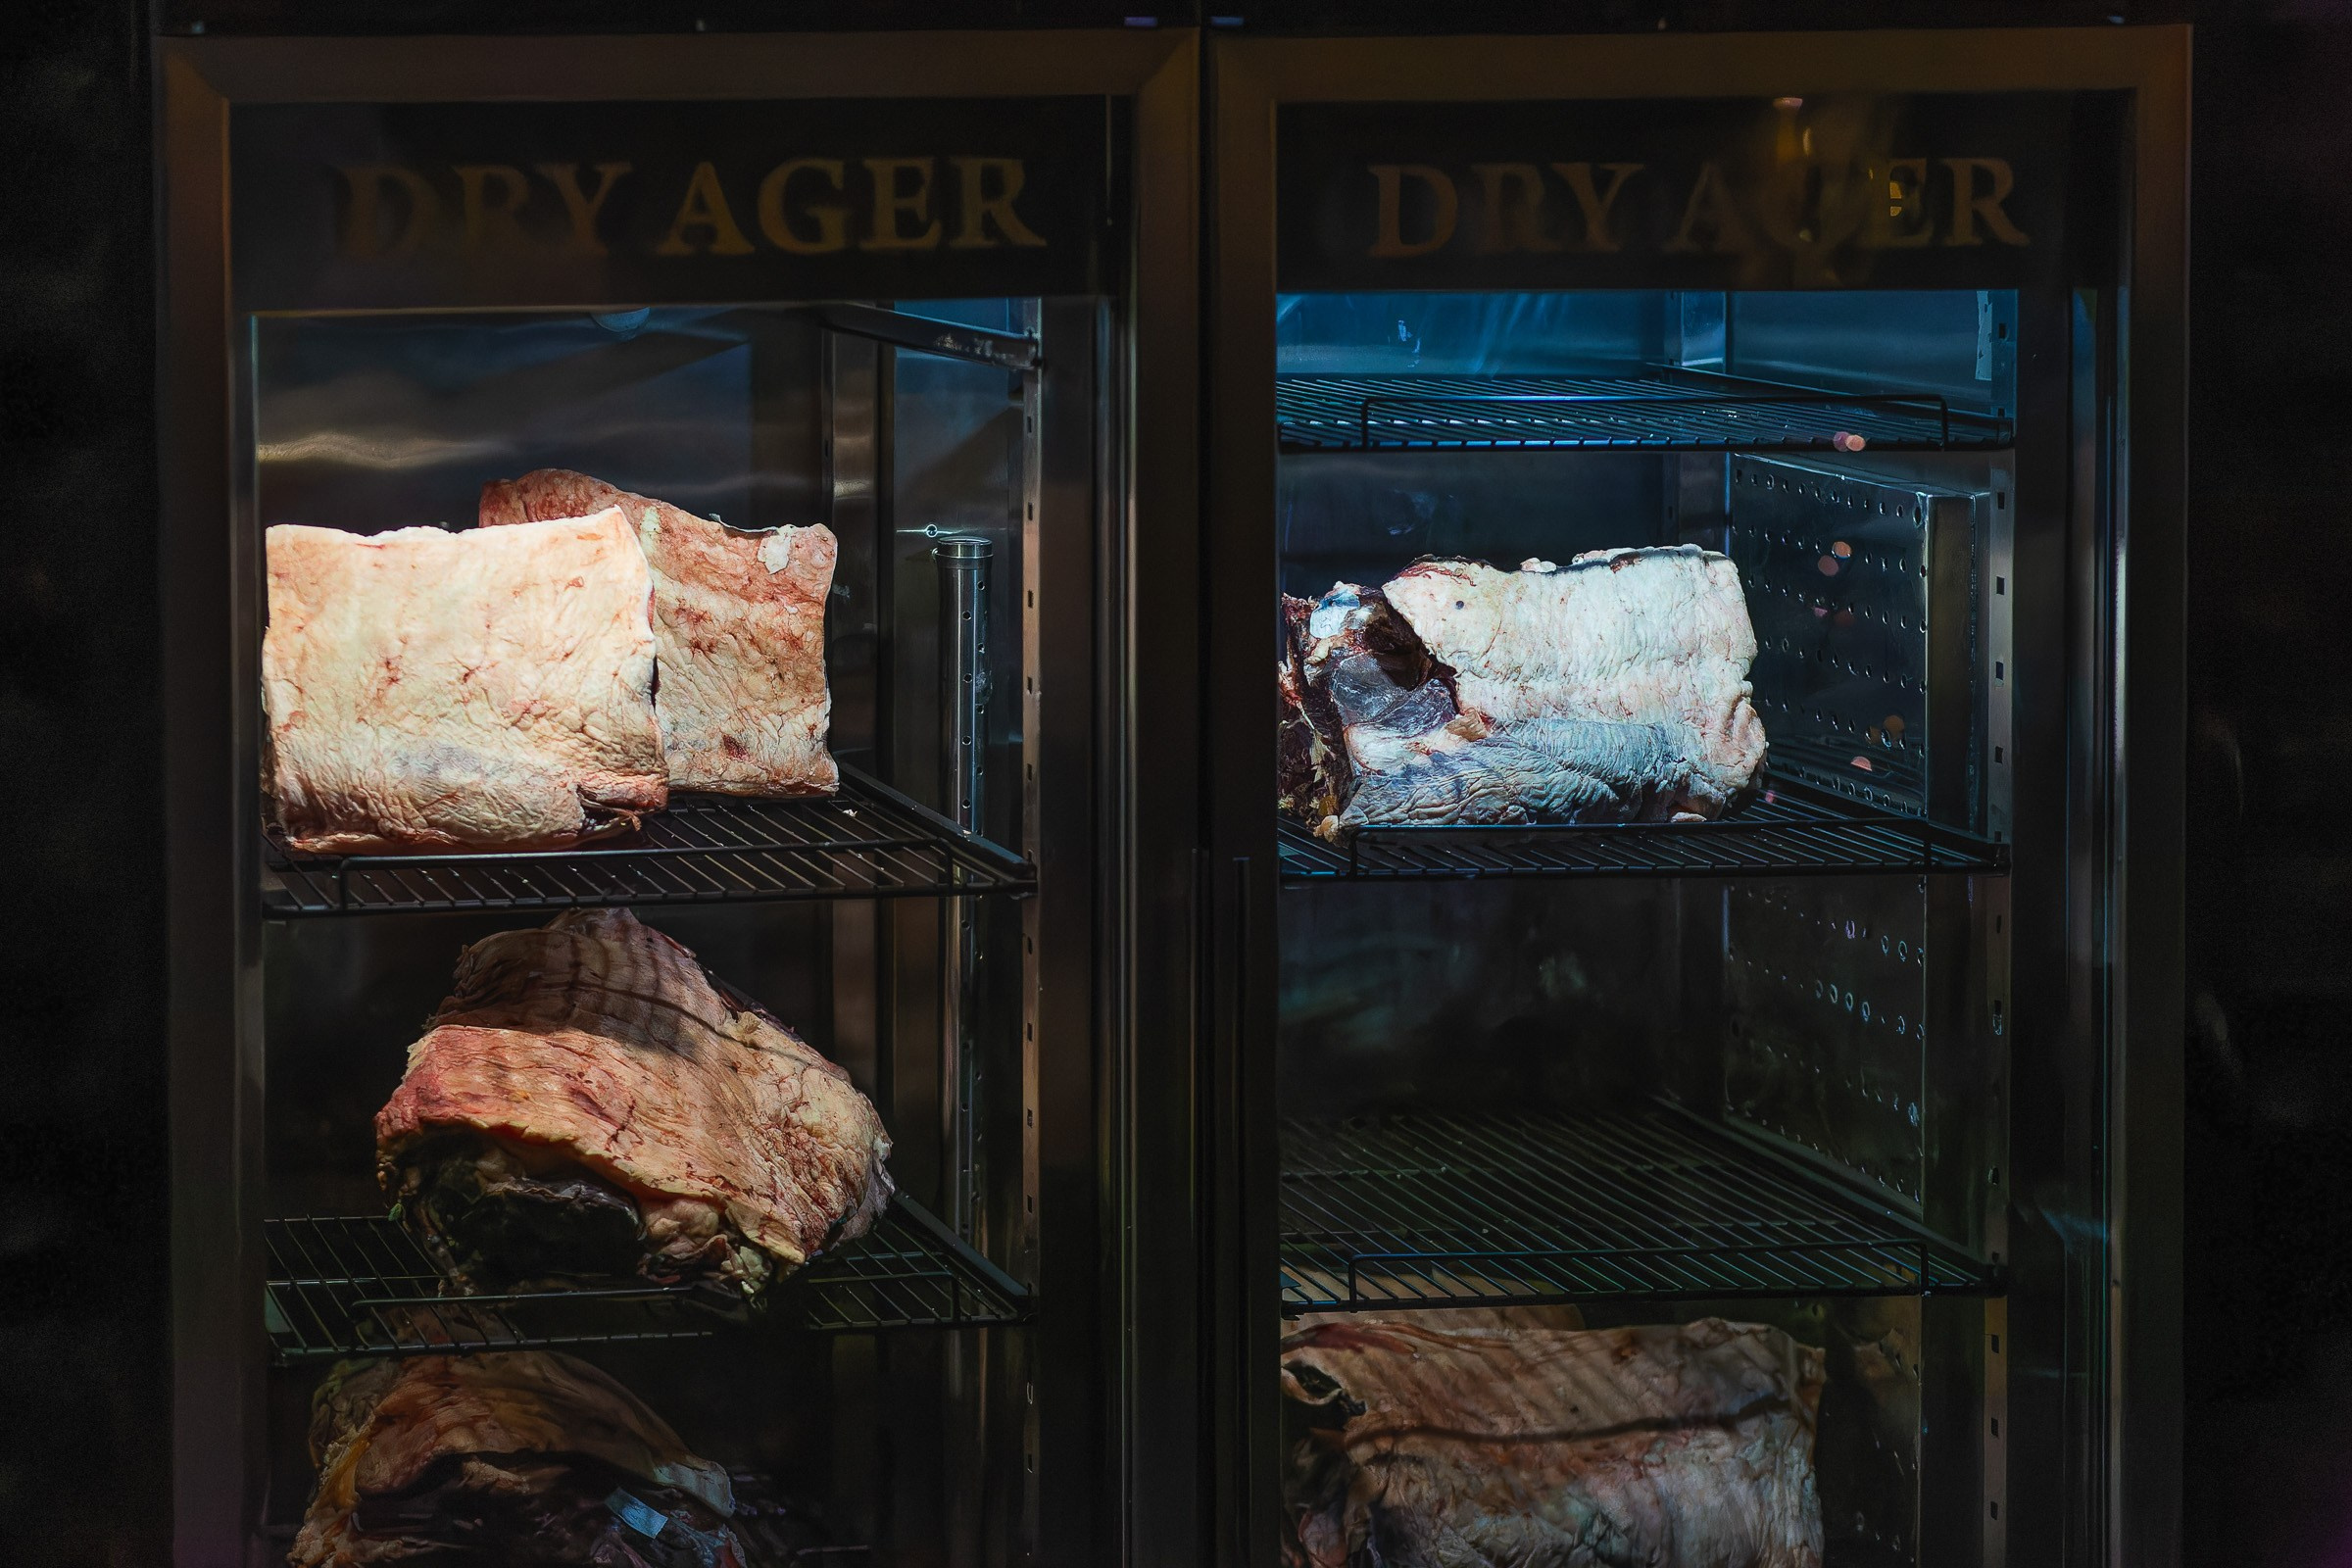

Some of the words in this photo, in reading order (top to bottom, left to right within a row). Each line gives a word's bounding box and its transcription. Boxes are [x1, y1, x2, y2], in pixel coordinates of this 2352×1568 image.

[335, 162, 632, 258] DRY
[656, 156, 1048, 256] AGER
[1367, 162, 1644, 258] DRY
